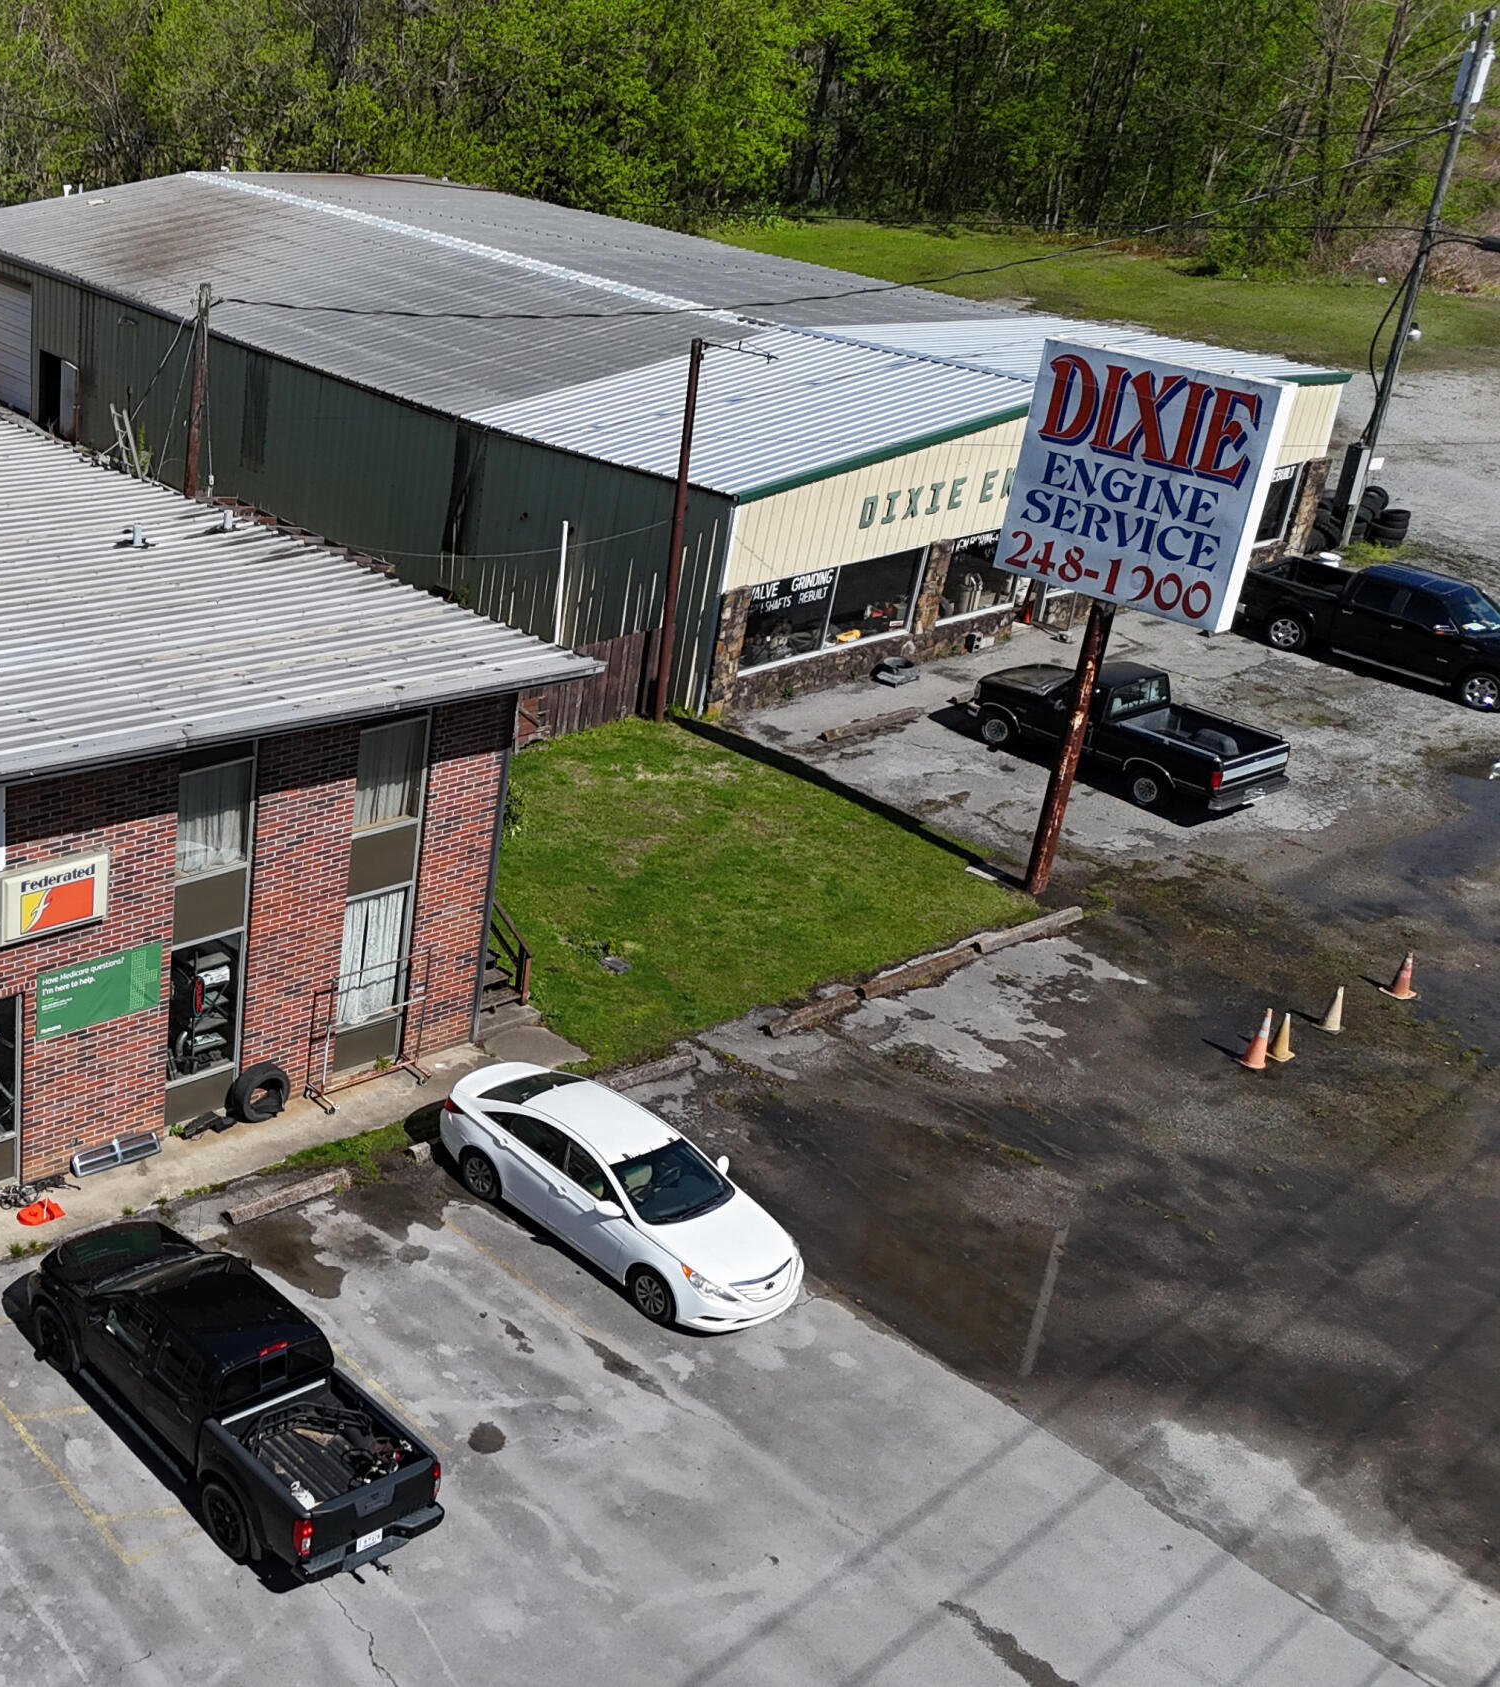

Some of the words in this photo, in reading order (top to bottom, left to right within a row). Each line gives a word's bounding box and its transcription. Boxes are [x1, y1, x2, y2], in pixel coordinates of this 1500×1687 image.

[1038, 354, 1262, 490] DIXIE
[859, 476, 968, 530] DIXIE
[1040, 451, 1220, 528] ENGINE
[1020, 489, 1221, 572] SERVICE
[791, 569, 834, 592] GRINDING
[798, 586, 829, 605] REBUILT
[21, 863, 96, 893] Federated
[41, 975, 59, 986] Have
[59, 966, 90, 981] Medicare
[90, 956, 125, 973] questions?
[41, 988, 55, 996] I'm
[54, 983, 71, 993] here
[70, 980, 79, 988] to
[79, 975, 96, 987] help.
